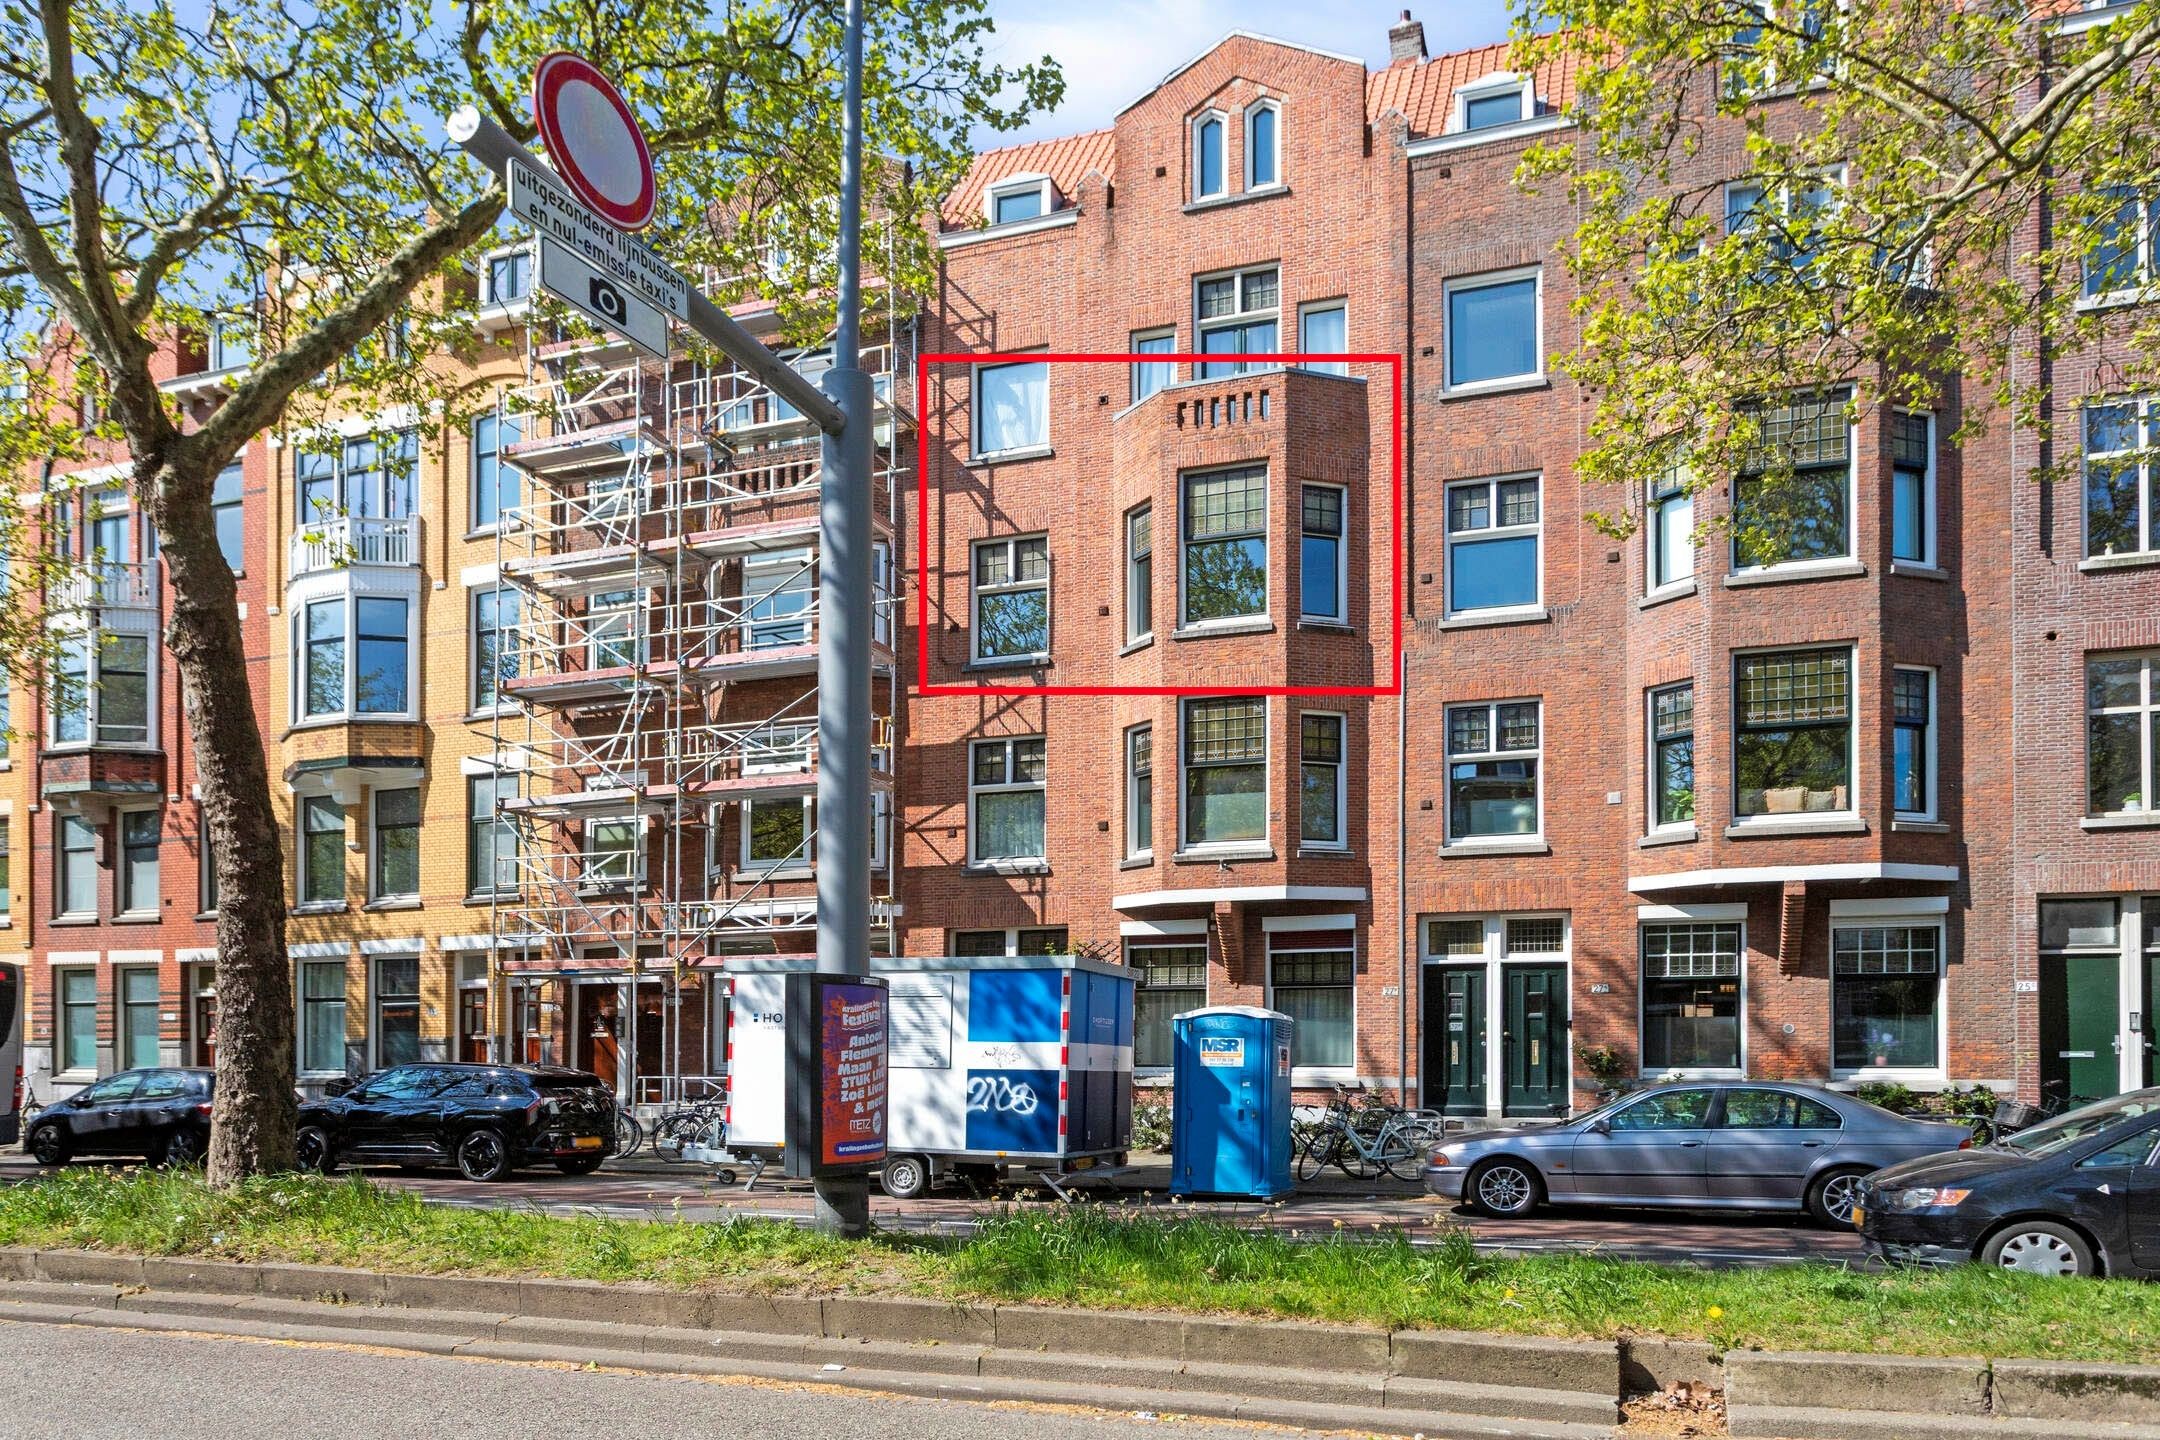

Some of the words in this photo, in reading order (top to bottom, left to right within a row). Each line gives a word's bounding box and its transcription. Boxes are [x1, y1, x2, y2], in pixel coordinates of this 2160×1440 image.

[516, 168, 613, 246] uitgezonderd
[618, 234, 685, 295] lijnbussen
[529, 202, 548, 226] en
[553, 218, 637, 284] nul-emissie
[640, 272, 676, 310] taxi's
[1202, 1038, 1240, 1052] MSR
[837, 1060, 872, 1077] Maan
[854, 1102, 864, 1114] &
